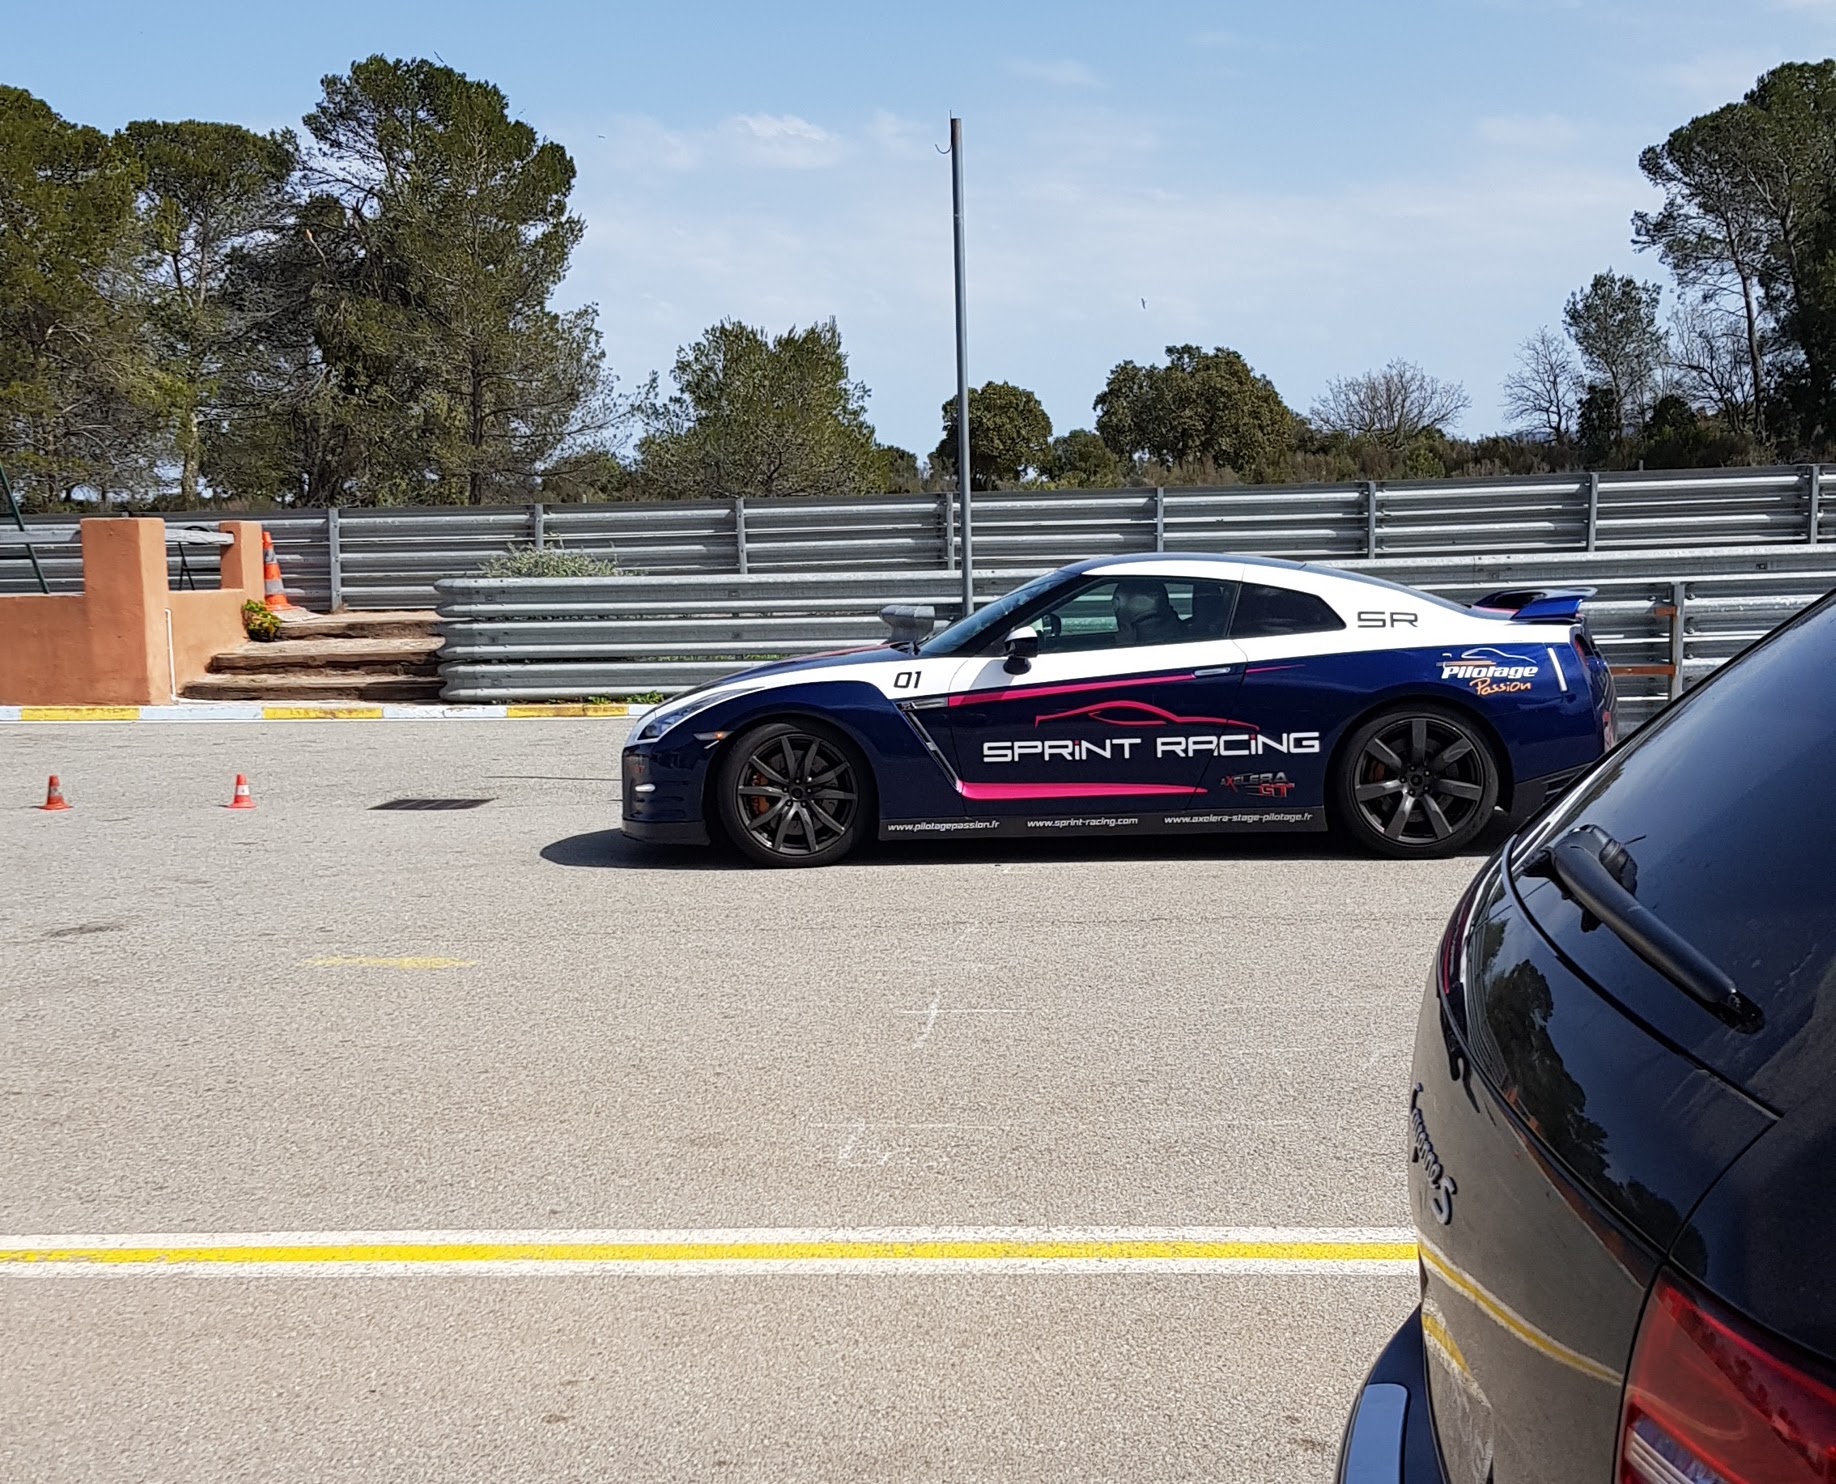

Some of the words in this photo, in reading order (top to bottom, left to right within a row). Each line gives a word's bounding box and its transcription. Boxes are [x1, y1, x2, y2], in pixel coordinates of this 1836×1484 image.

[1357, 611, 1419, 628] SR
[1441, 664, 1539, 679] Pilotage
[893, 671, 922, 689] 01
[1469, 678, 1532, 696] Passion
[1259, 783, 1296, 798] GT
[1027, 817, 1139, 828] www.sprint-racing.com
[1164, 812, 1313, 824] www.axelera-stage-pilotage.fr
[887, 820, 1001, 832] www.pilotagepassion.fr
